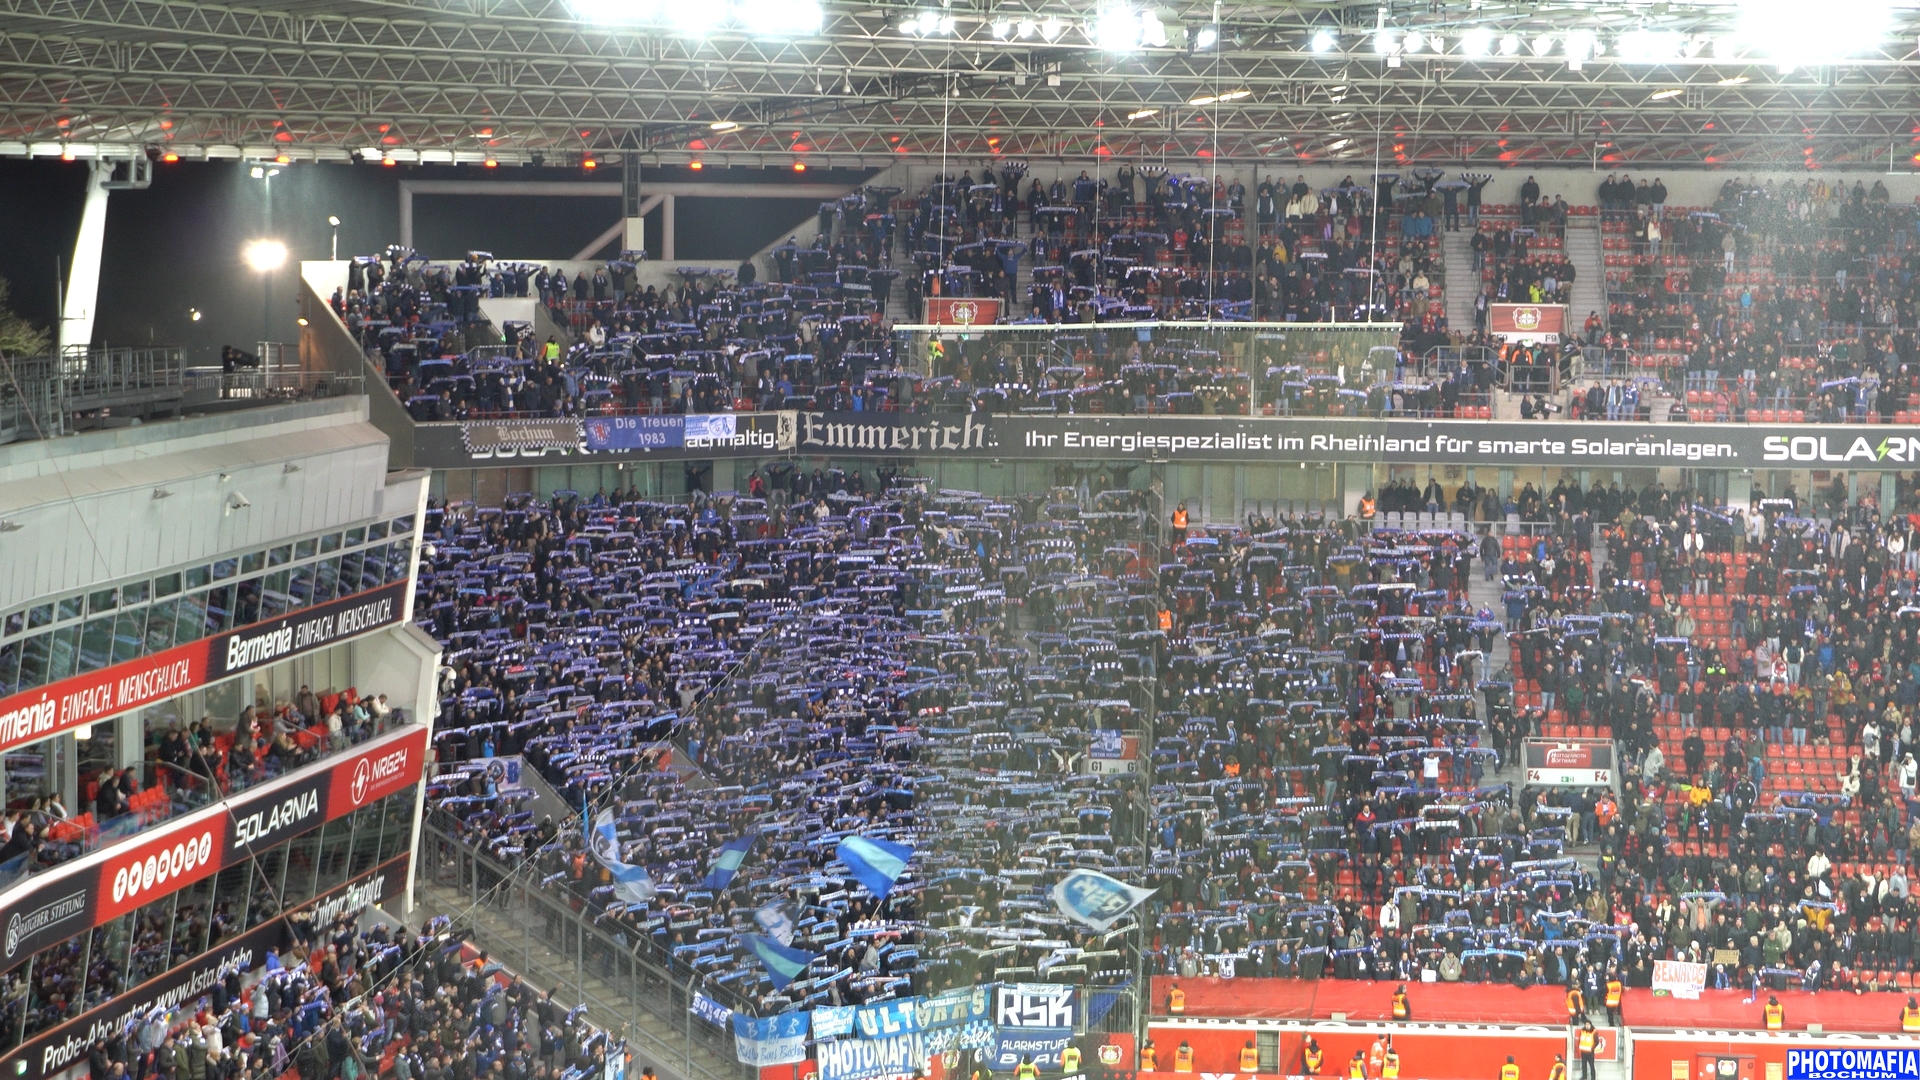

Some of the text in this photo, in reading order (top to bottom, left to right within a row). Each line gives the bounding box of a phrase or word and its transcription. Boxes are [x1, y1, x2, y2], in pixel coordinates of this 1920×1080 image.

[496, 425, 555, 443] Bochum
[615, 418, 636, 430] Die
[641, 416, 684, 428] Treuen
[638, 432, 666, 445] 1983
[802, 411, 987, 451] Emmerich
[1026, 430, 1738, 461] Ihr Energiespezialist im Rheinland für smarte Solaranlagen.
[226, 597, 392, 671] Barmenia EINFACH. MENSCHLICH.
[60, 682, 113, 725] EINFACH.
[117, 658, 191, 706] MENSCHLICH.
[371, 747, 408, 781] NRG24
[1091, 761, 1102, 771] G1
[1527, 770, 1540, 781] F4
[1594, 771, 1607, 782] F4
[234, 788, 319, 849] SOLARNIA
[20, 893, 86, 937] RATGEBER STIFTUNG
[1653, 961, 1706, 985] BERNARDO
[998, 986, 1073, 1027] RSK
[817, 1033, 924, 1080] PHOTOMAFIA
[1001, 1037, 1071, 1051] ALARMSTUFE
